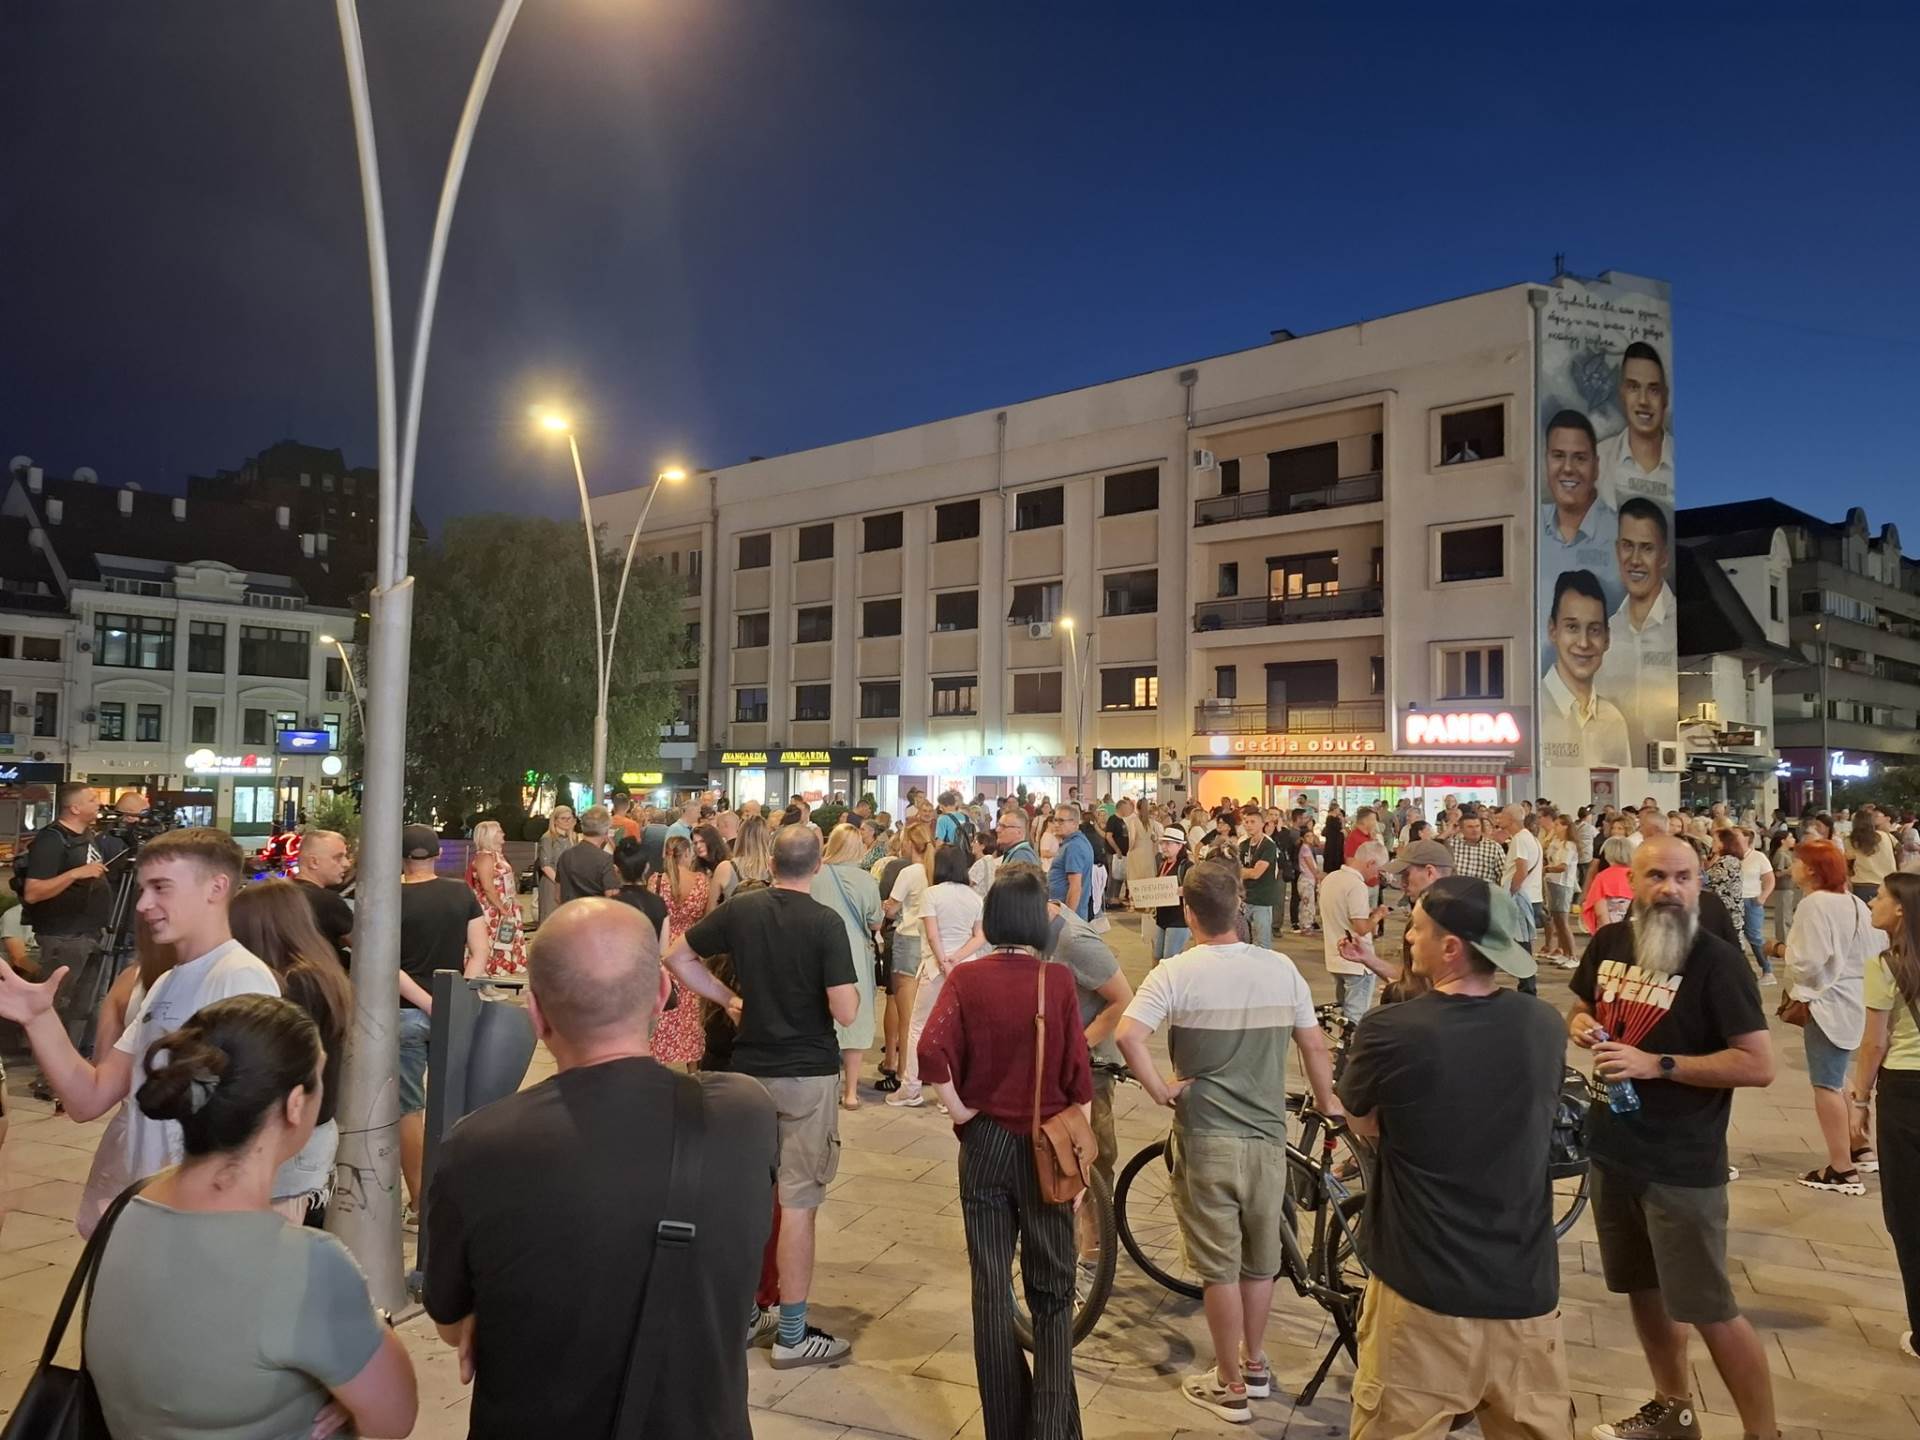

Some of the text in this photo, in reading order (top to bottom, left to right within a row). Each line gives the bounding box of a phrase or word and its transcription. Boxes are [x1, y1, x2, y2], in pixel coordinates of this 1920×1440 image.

[1405, 712, 1521, 744] PANDA
[721, 752, 768, 761] AVANGARDIA
[779, 751, 831, 761] AVANGARDIA
[1101, 750, 1149, 768] Bonatti
